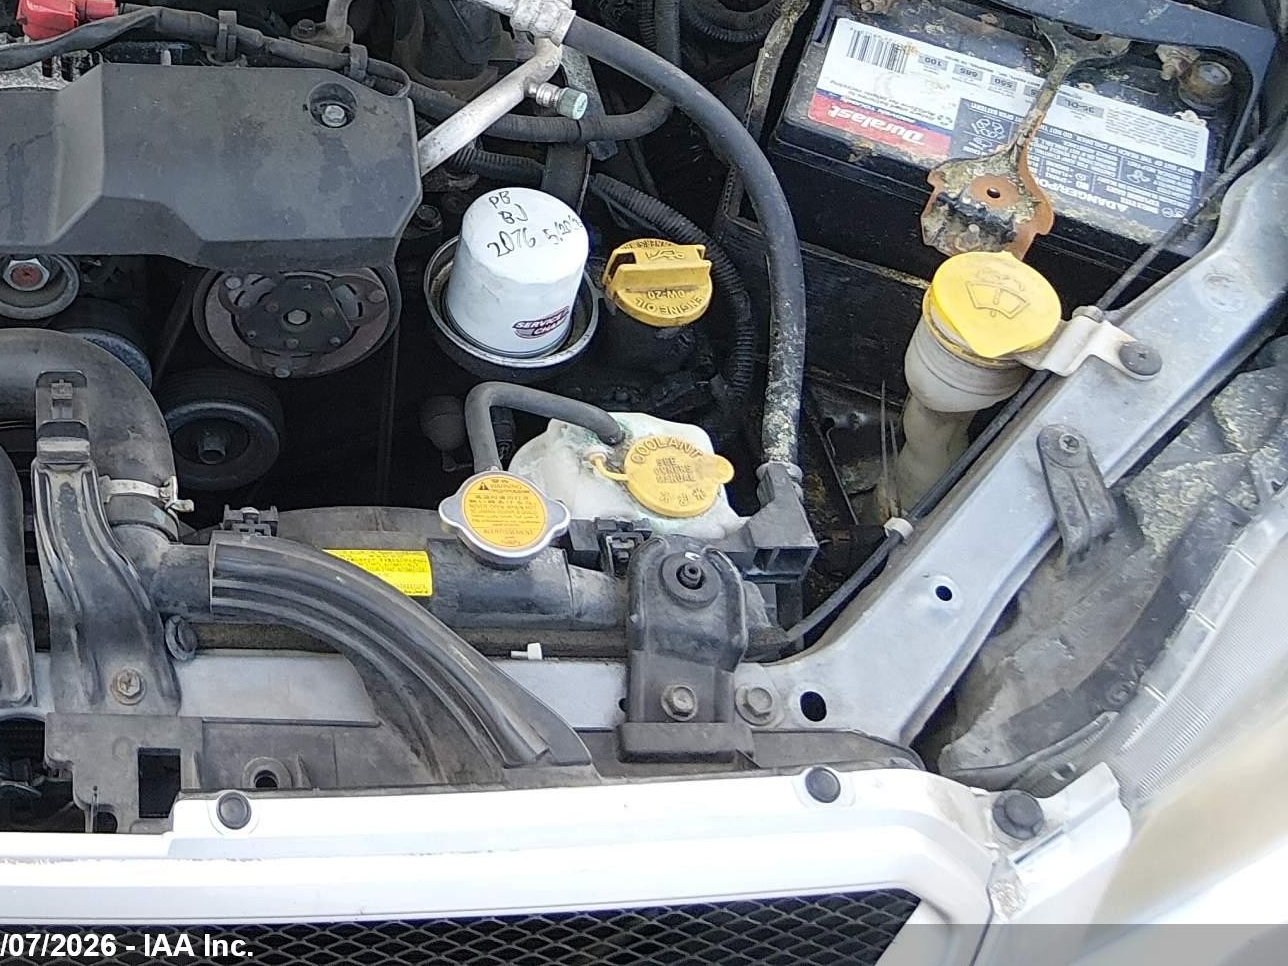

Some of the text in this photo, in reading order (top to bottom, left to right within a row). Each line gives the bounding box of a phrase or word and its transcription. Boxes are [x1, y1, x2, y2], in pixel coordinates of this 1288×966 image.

[828, 105, 925, 142] Duralast
[634, 295, 702, 316] ENGINE OIL
[647, 289, 685, 299] 0W-20
[631, 437, 703, 464] COOLANT
